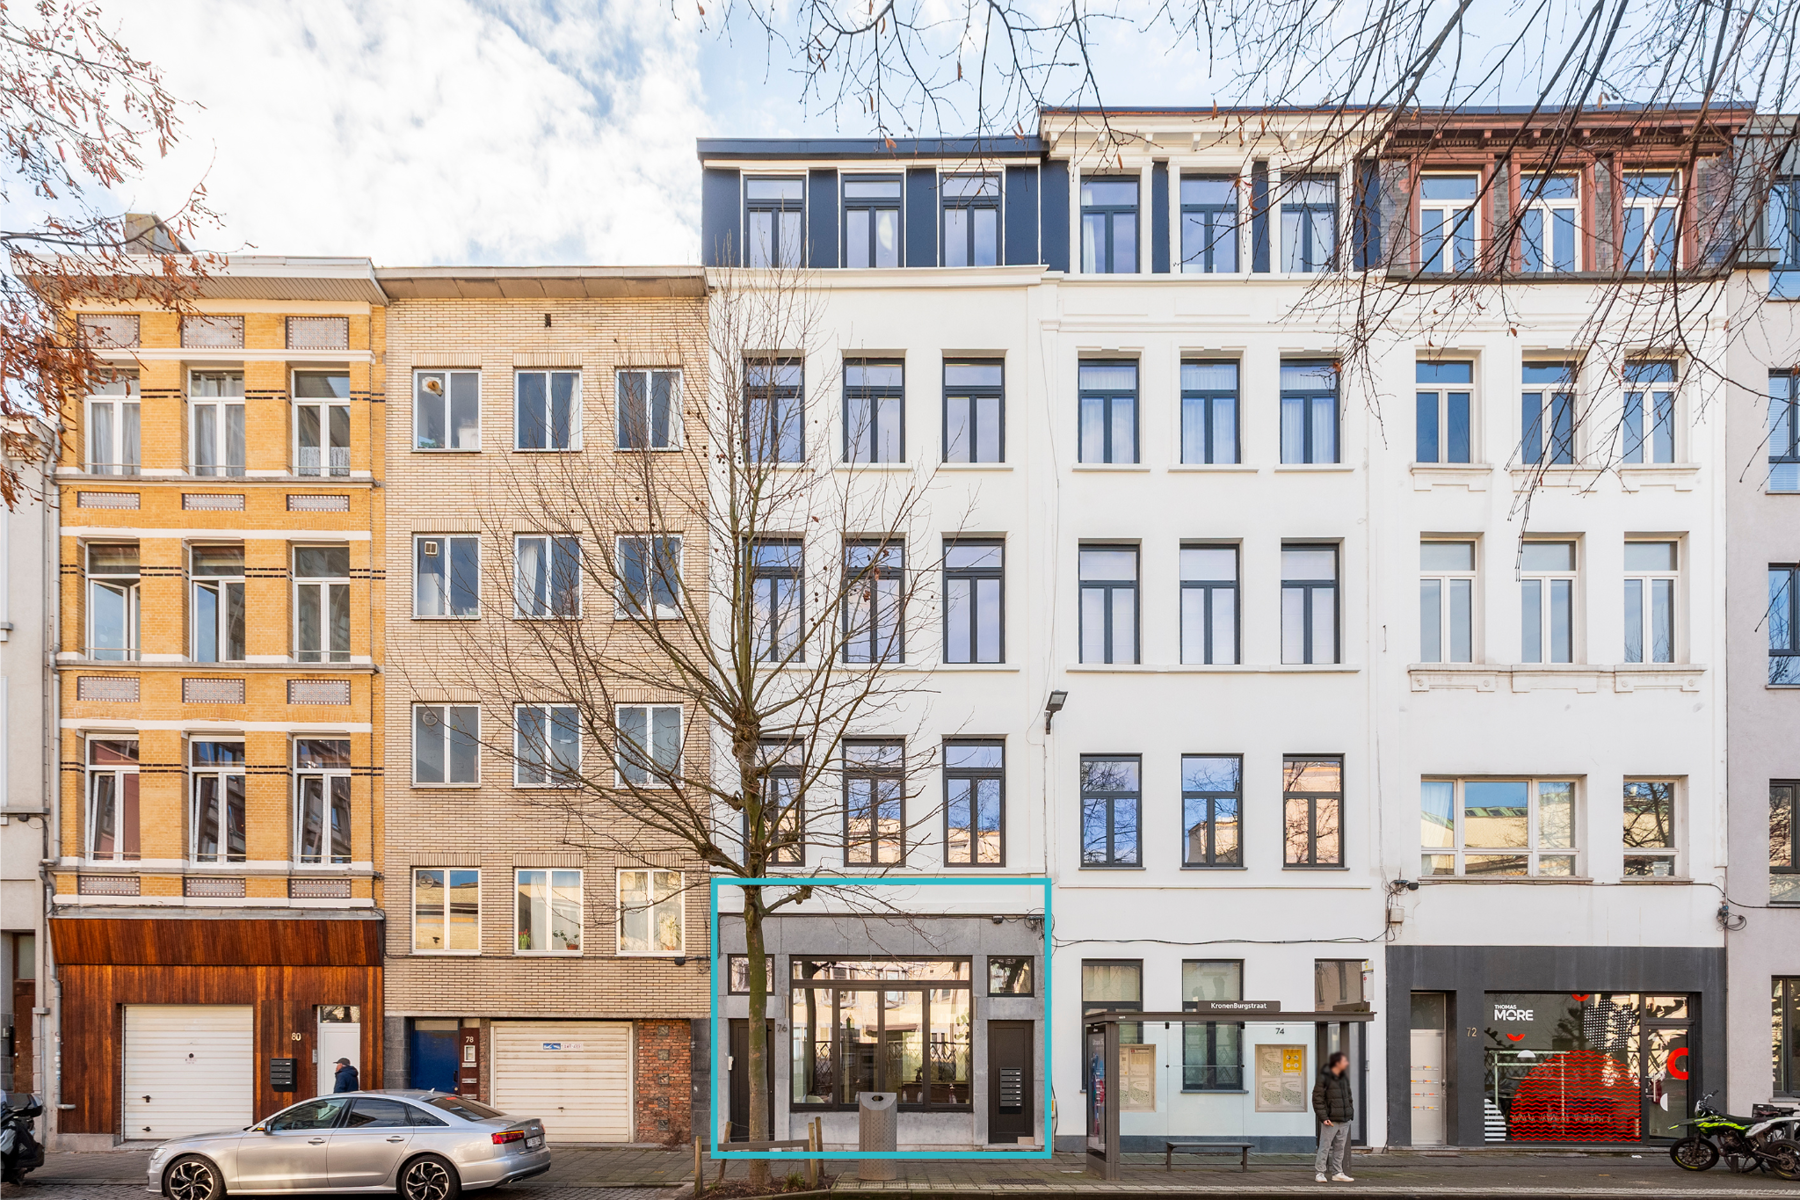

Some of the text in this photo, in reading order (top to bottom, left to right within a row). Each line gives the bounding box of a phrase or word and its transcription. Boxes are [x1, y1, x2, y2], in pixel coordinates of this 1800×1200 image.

[1210, 1002, 1267, 1010] KronenBurgstraat
[1494, 1010, 1534, 1021] MORE
[777, 1023, 788, 1033] 76
[1275, 1027, 1285, 1035] 74
[1466, 1027, 1477, 1037] 72
[291, 1032, 301, 1041] 80
